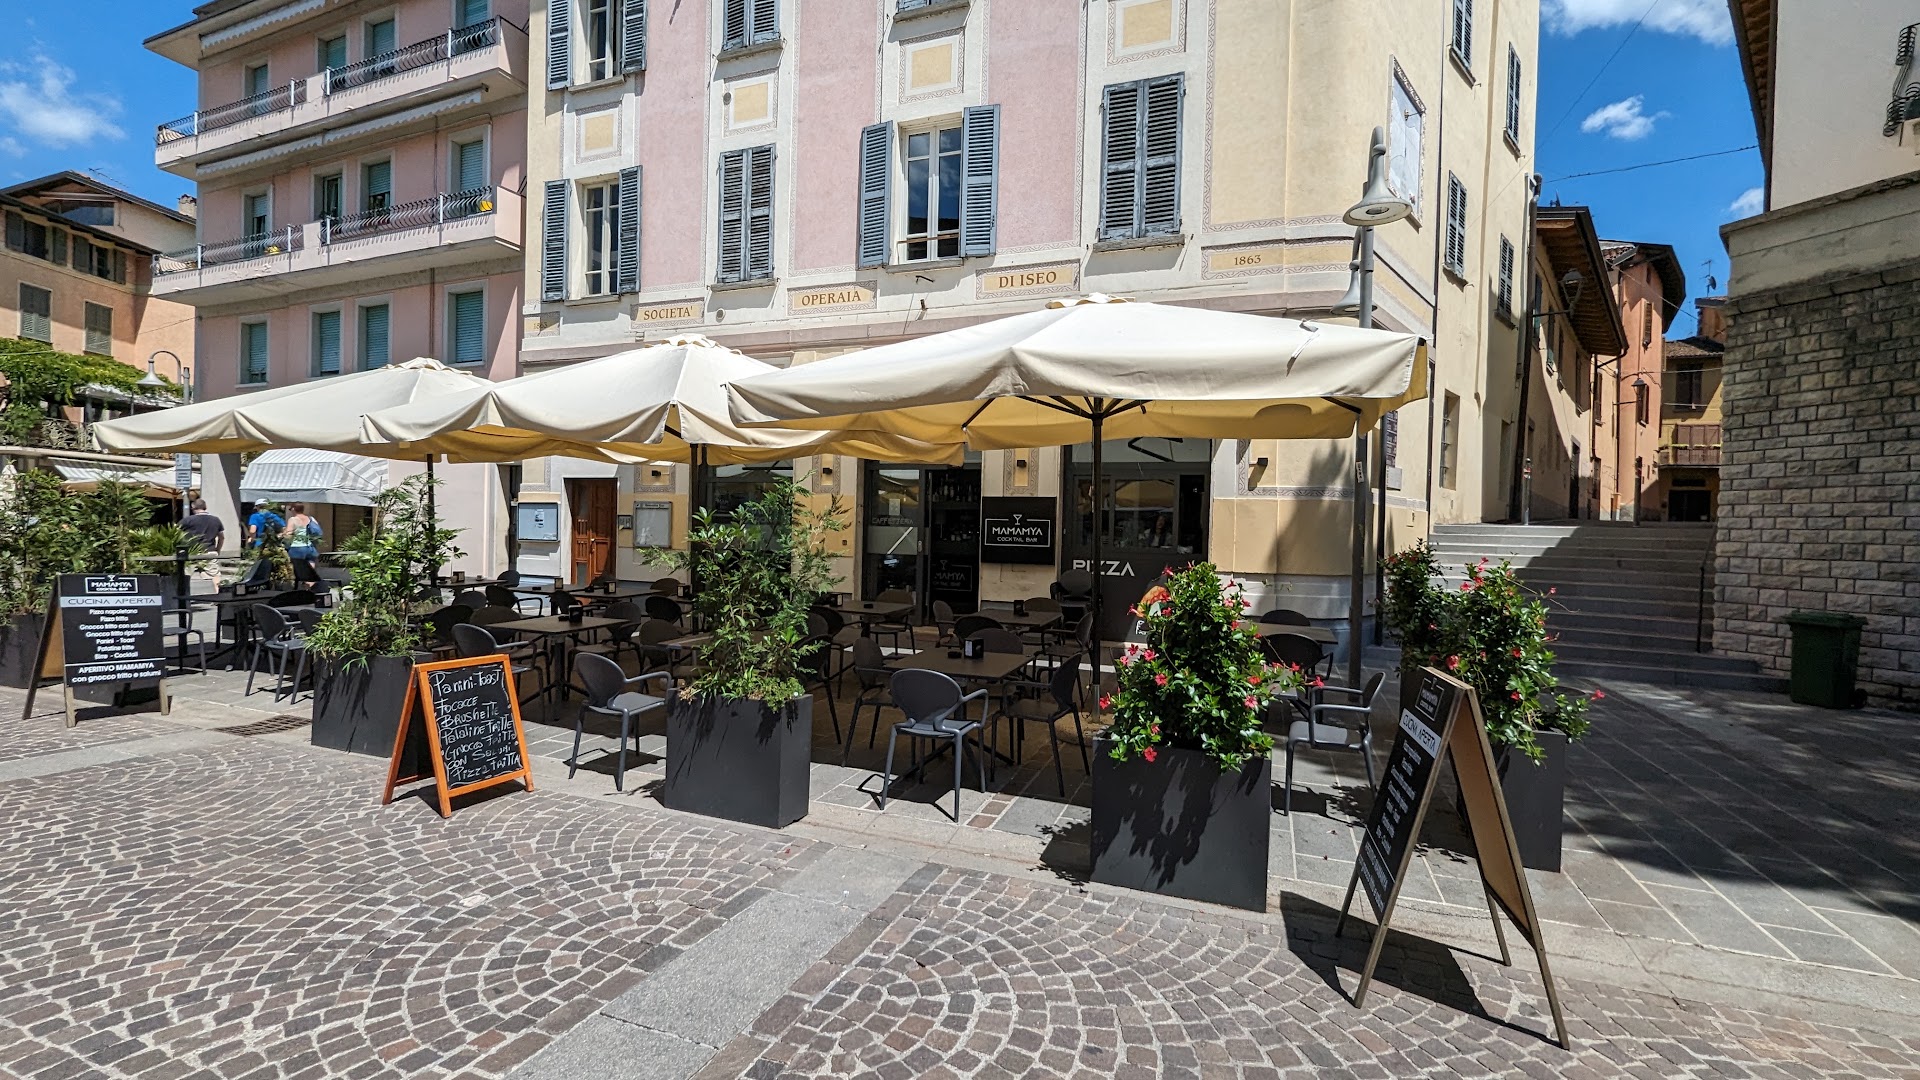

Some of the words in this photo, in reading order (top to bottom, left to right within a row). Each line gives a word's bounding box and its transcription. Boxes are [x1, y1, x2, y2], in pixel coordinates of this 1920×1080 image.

[1234, 254, 1262, 266] 1863
[644, 305, 693, 321] SOCIETA'
[801, 290, 862, 306] OPERAIA
[998, 275, 1014, 289] DI
[1019, 270, 1058, 287] ISEO
[992, 526, 1043, 536] MAMAMYA
[67, 598, 110, 606] CUCINA
[115, 597, 156, 605] APERTA
[78, 664, 115, 674] APERITIVO
[115, 662, 155, 671] MAMAMYA
[87, 674, 116, 683] gnocco
[139, 669, 162, 677] salumi
